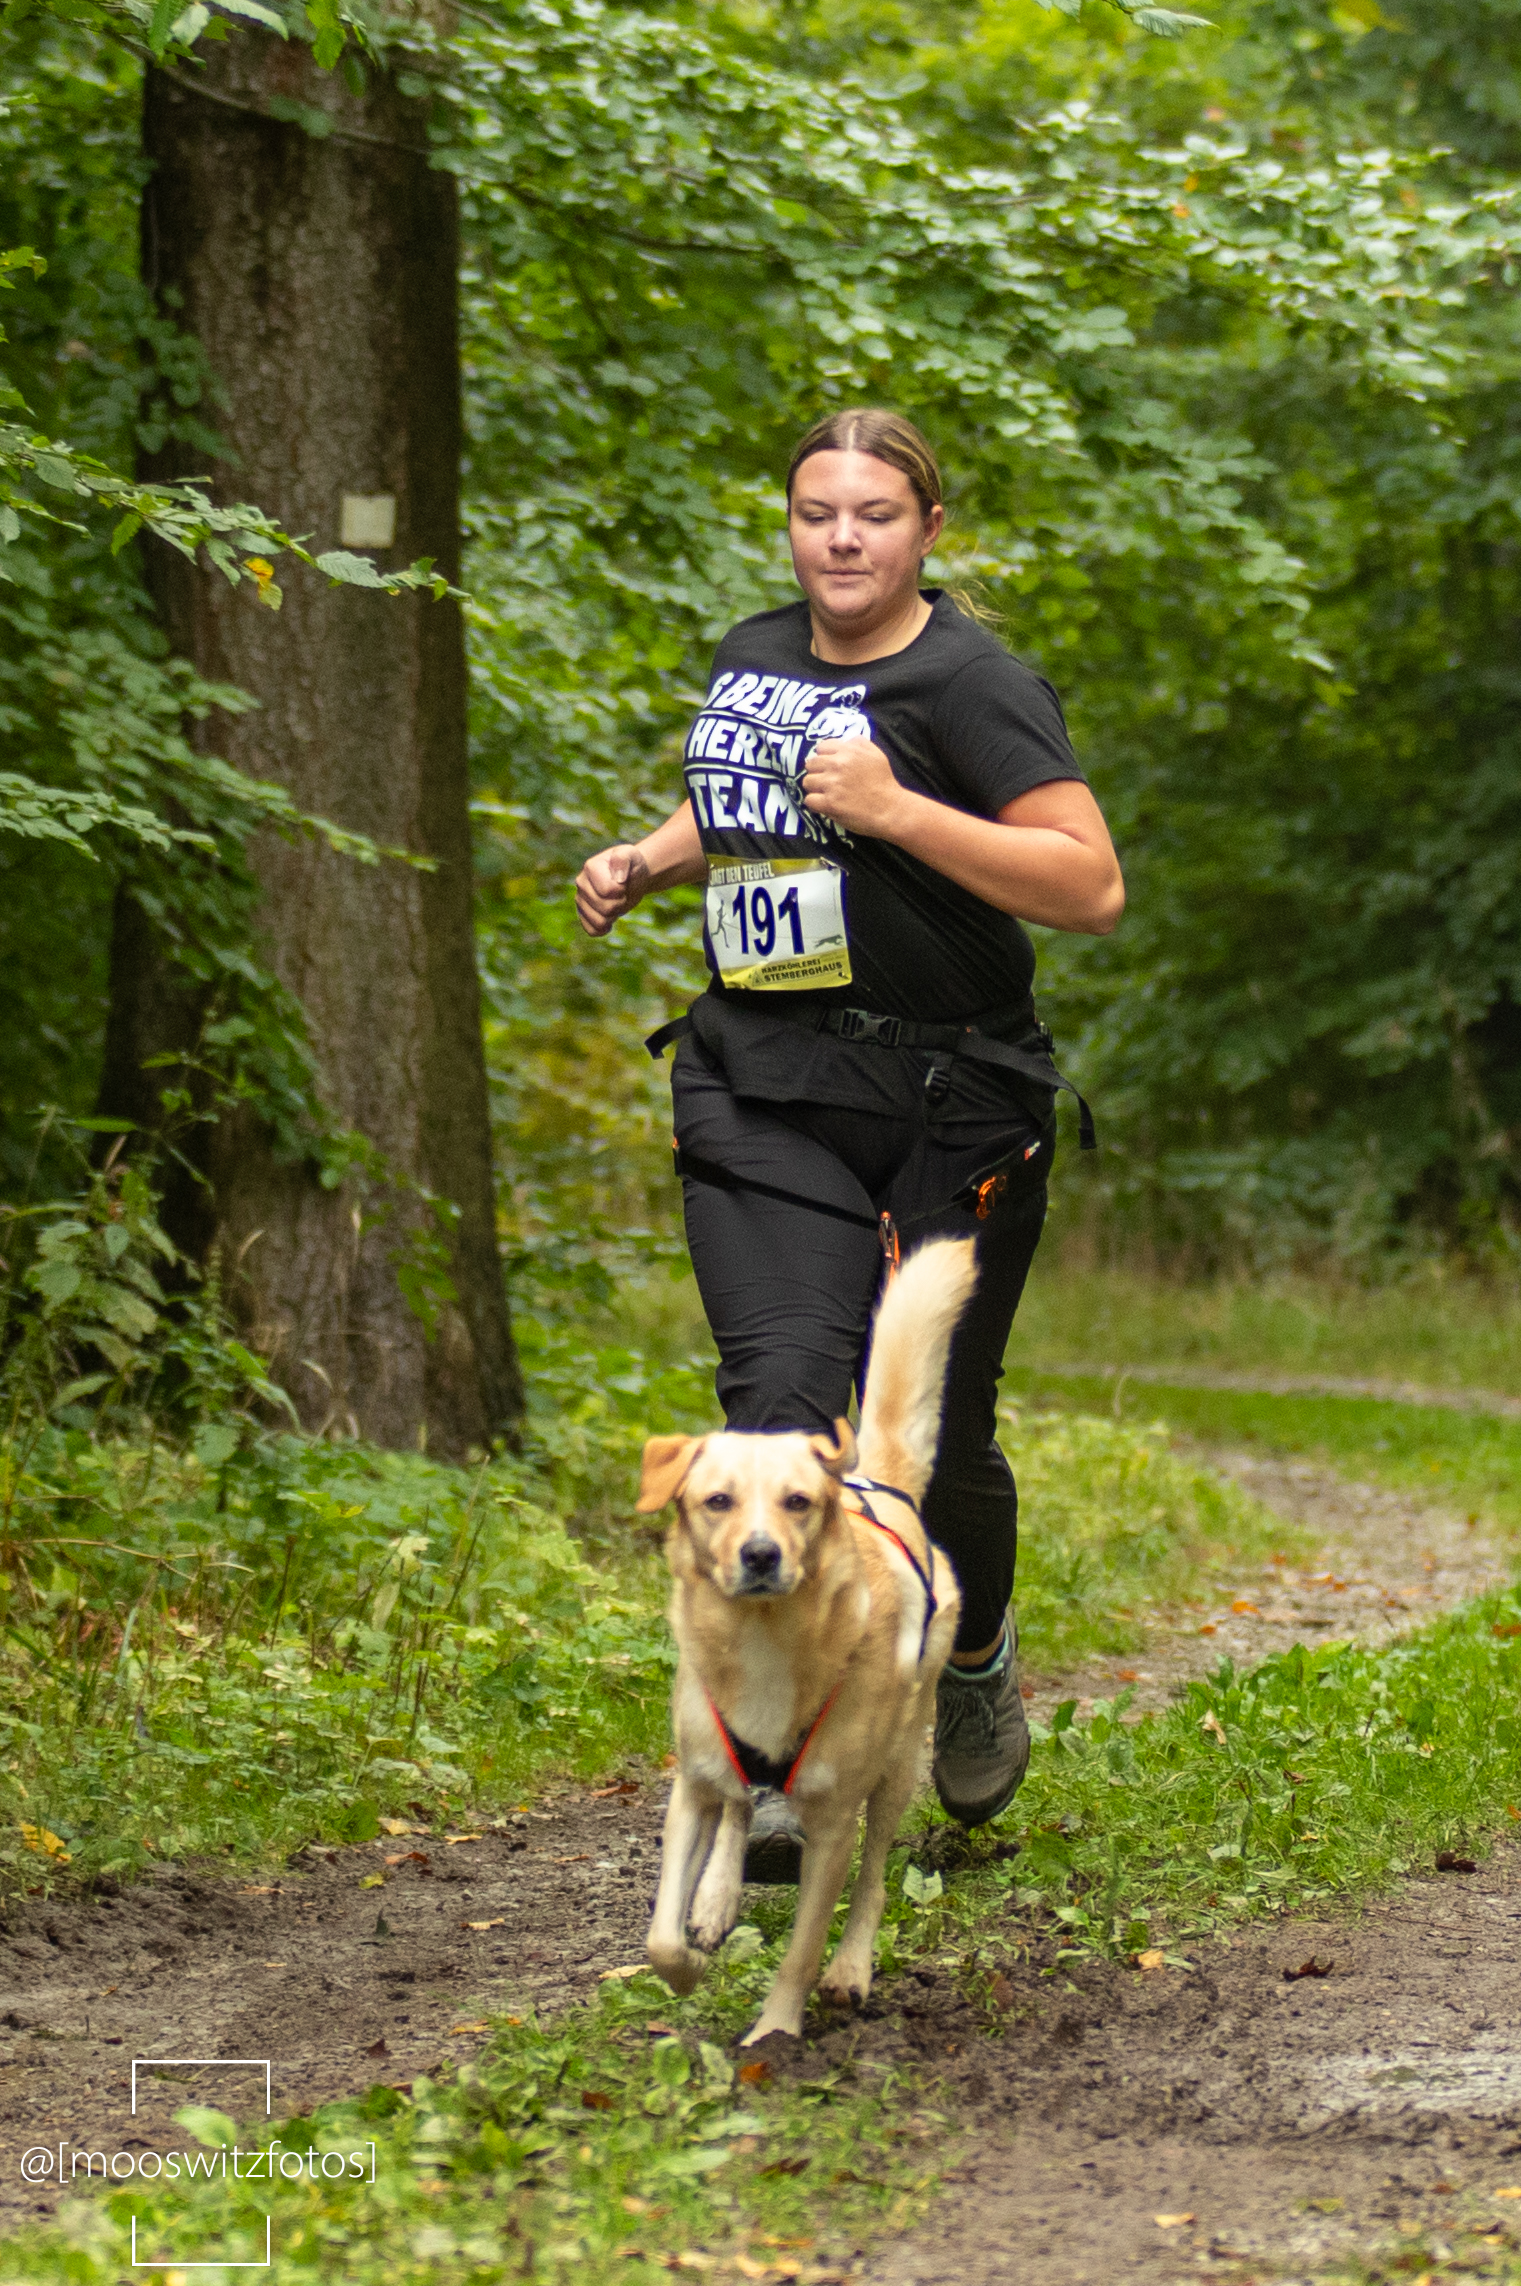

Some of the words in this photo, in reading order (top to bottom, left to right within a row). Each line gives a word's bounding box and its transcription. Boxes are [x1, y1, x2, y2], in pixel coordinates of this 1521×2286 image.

[687, 717, 804, 777] HERZEN
[687, 773, 800, 836] TEAM
[742, 861, 775, 881] TEUFEL
[732, 885, 805, 957] 191
[764, 962, 843, 982] STEMBERGHAUS
